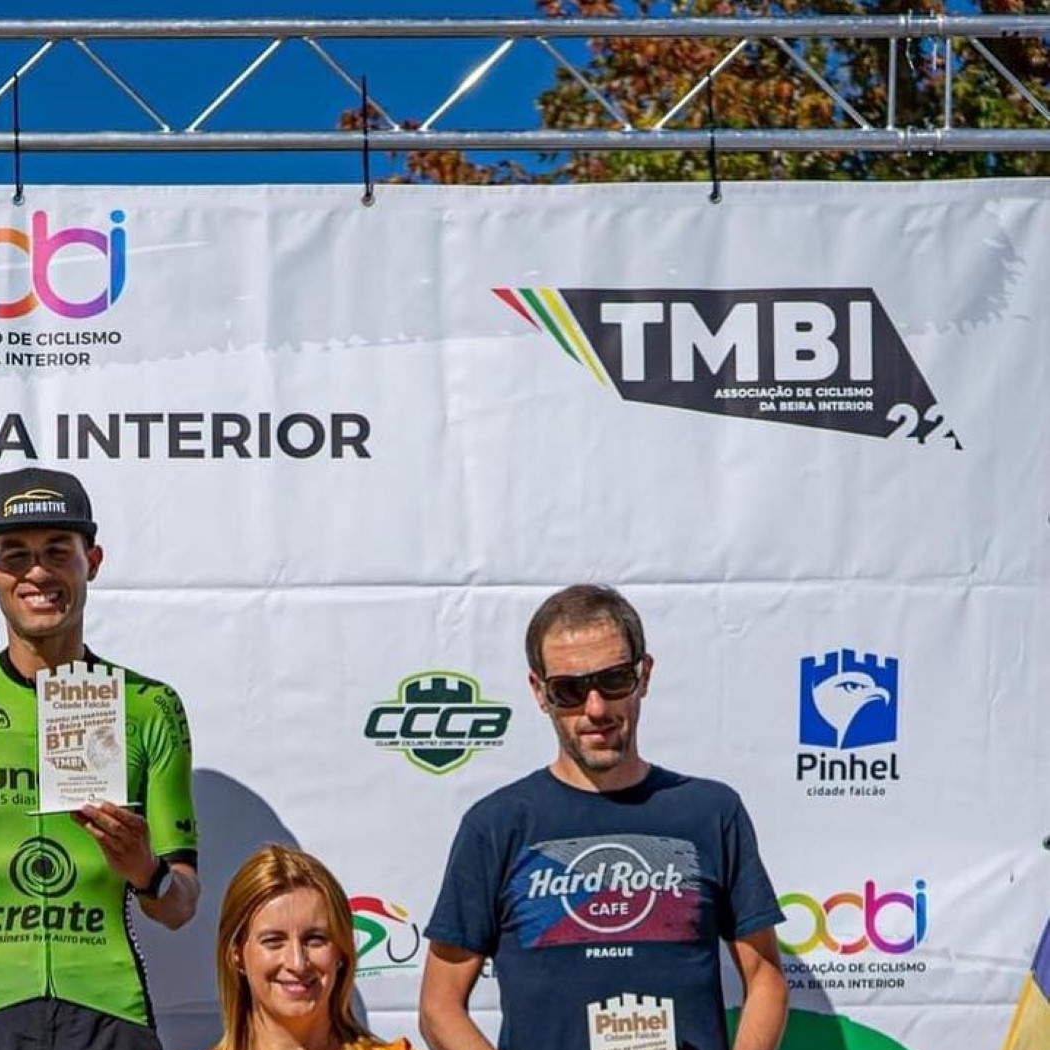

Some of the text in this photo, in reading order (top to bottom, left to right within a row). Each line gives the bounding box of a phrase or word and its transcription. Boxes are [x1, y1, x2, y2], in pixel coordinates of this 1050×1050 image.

[7, 332, 31, 346] DE
[36, 331, 122, 346] CICLISMO
[600, 301, 873, 382] TMBI
[5, 352, 91, 367] INTERIOR
[714, 386, 874, 400] ASSOCIAÇÃO DE CICLISMO
[759, 401, 874, 412] DA BEIRA INTERIOR
[57, 412, 372, 460] INTERIOR
[44, 679, 119, 702] Pinhel
[364, 706, 513, 739] CCCB
[46, 729, 87, 750] BTT
[796, 752, 900, 781] Pinhel
[806, 785, 886, 797] cidade falcão
[528, 861, 683, 899] Hard Rock
[588, 902, 630, 916] CAFE
[585, 947, 634, 959] PRAGUE
[848, 963, 864, 973] DE
[868, 962, 927, 973] CICLISMO
[808, 979, 845, 989] BEIRA
[848, 978, 905, 989] INTERIOR
[595, 1011, 667, 1034] Pinhel
